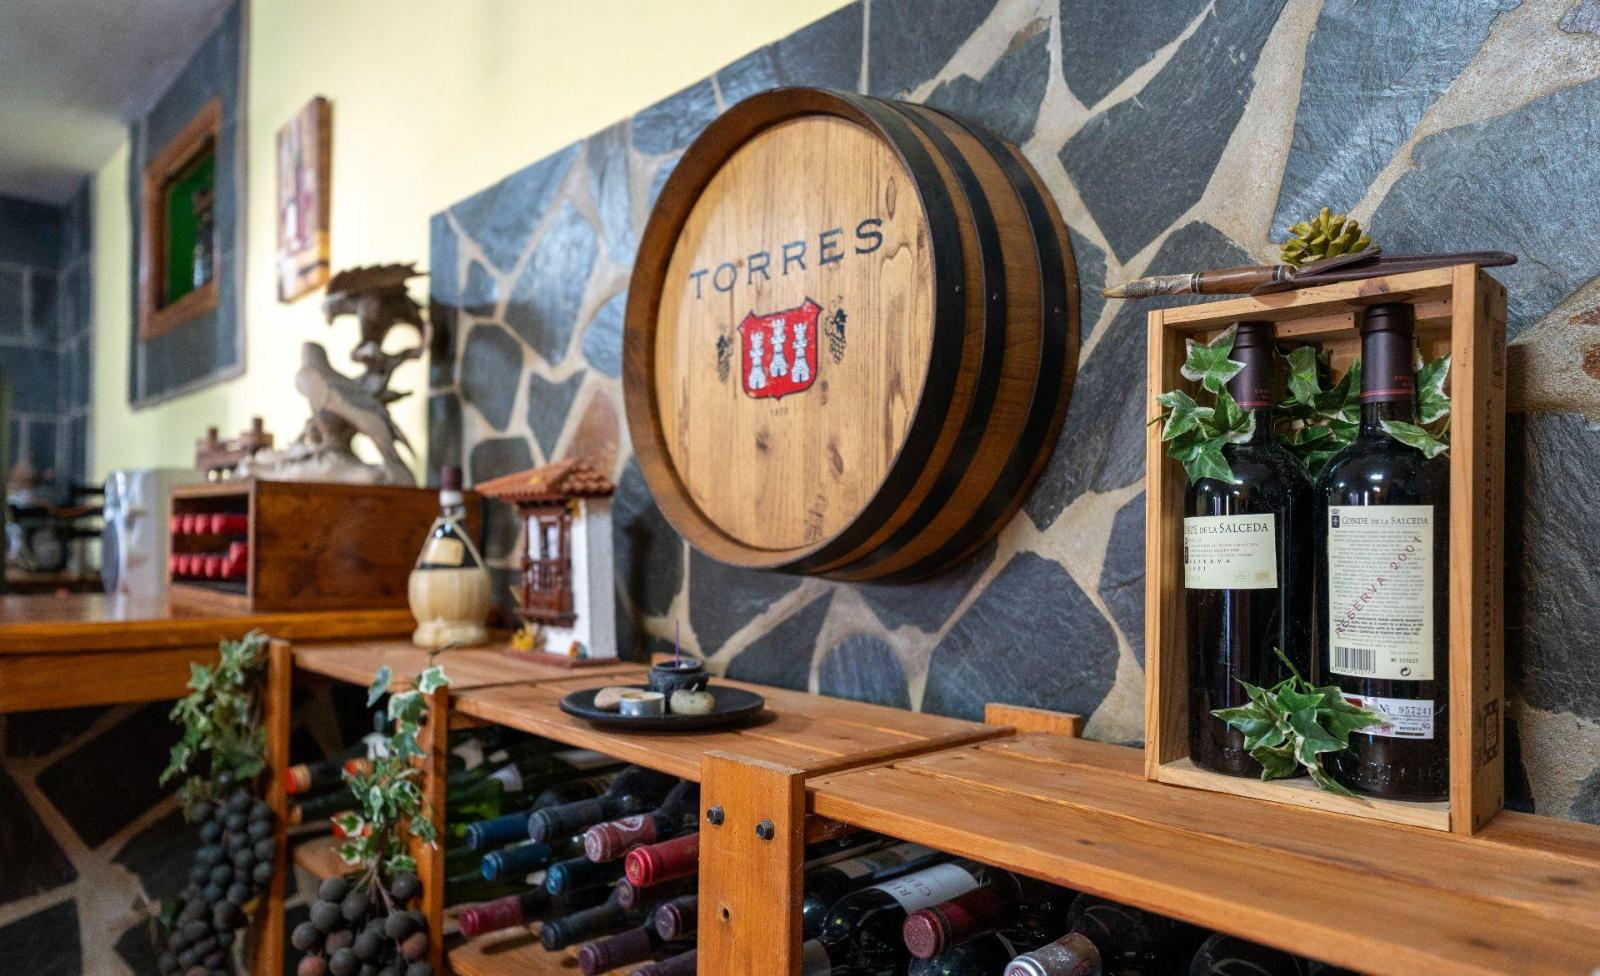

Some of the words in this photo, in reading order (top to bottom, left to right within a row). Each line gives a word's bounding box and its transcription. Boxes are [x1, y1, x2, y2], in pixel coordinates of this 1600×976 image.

[689, 218, 883, 299] TORRES
[1341, 516, 1369, 525] CONDE
[1381, 518, 1390, 526] LA
[1390, 516, 1429, 525] SALCEDA
[1199, 526, 1208, 534] DE
[1208, 526, 1218, 534] LA
[1219, 522, 1269, 534] SALCEDA
[1334, 577, 1388, 639] RESERVA
[1390, 536, 1422, 570] 2001
[1398, 706, 1432, 715] 957241
